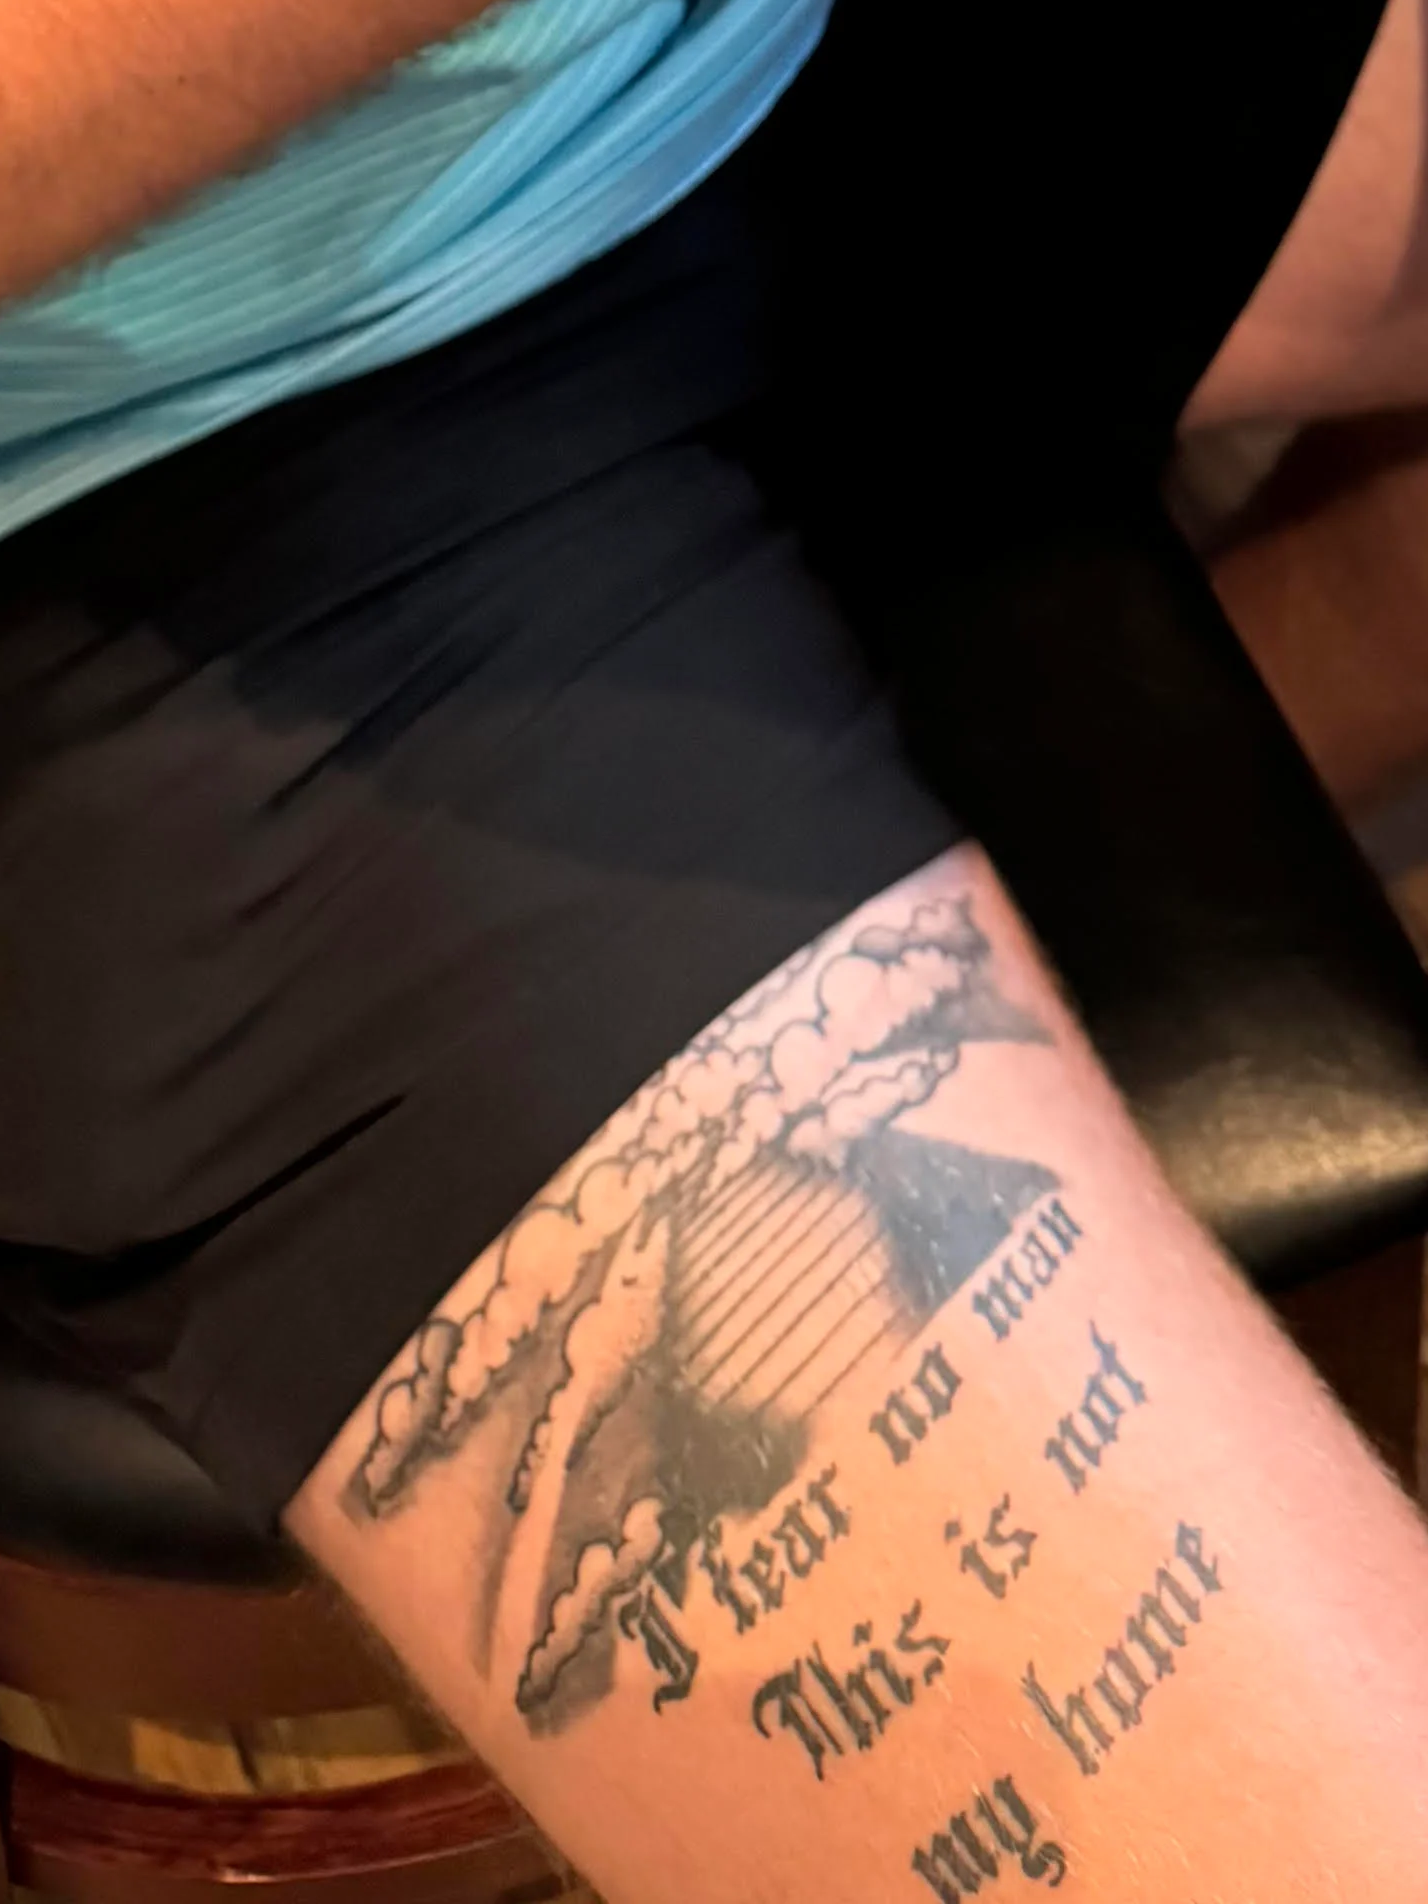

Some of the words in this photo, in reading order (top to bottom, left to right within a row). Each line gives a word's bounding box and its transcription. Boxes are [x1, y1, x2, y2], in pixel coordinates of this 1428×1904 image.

[698, 1462, 851, 1635] fear
[869, 1342, 963, 1467] no
[973, 1198, 1083, 1341] man
[753, 1598, 952, 1782] This
[944, 1492, 1039, 1600] is
[1045, 1319, 1149, 1496] not
[911, 1773, 1068, 1904] my
[1021, 1519, 1225, 1777] home
